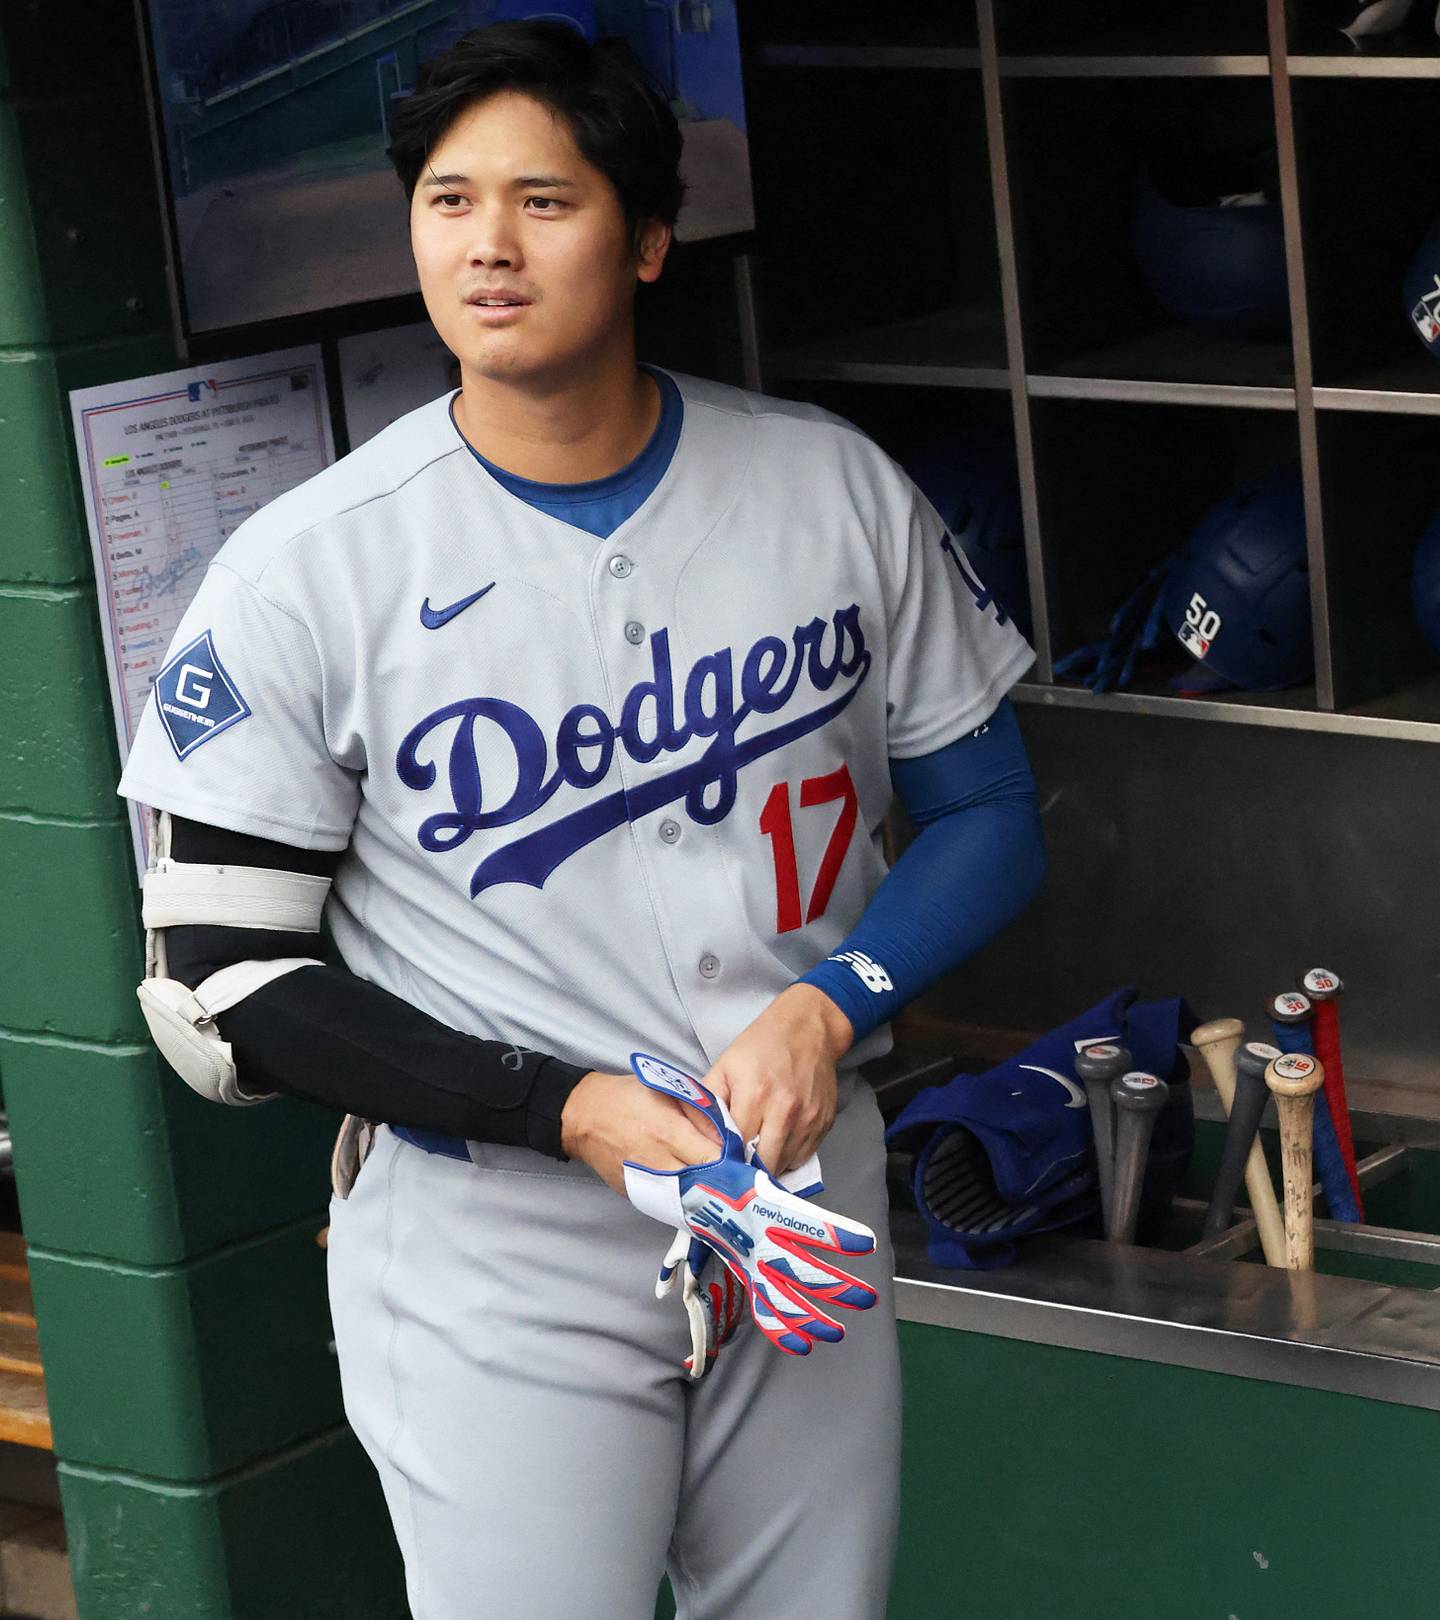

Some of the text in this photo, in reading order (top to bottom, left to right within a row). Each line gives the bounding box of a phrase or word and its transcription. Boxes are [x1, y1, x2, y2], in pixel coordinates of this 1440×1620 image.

[1185, 591, 1221, 641] 50
[176, 664, 213, 709] G
[396, 603, 870, 852] Dodgers
[760, 762, 859, 934] 17
